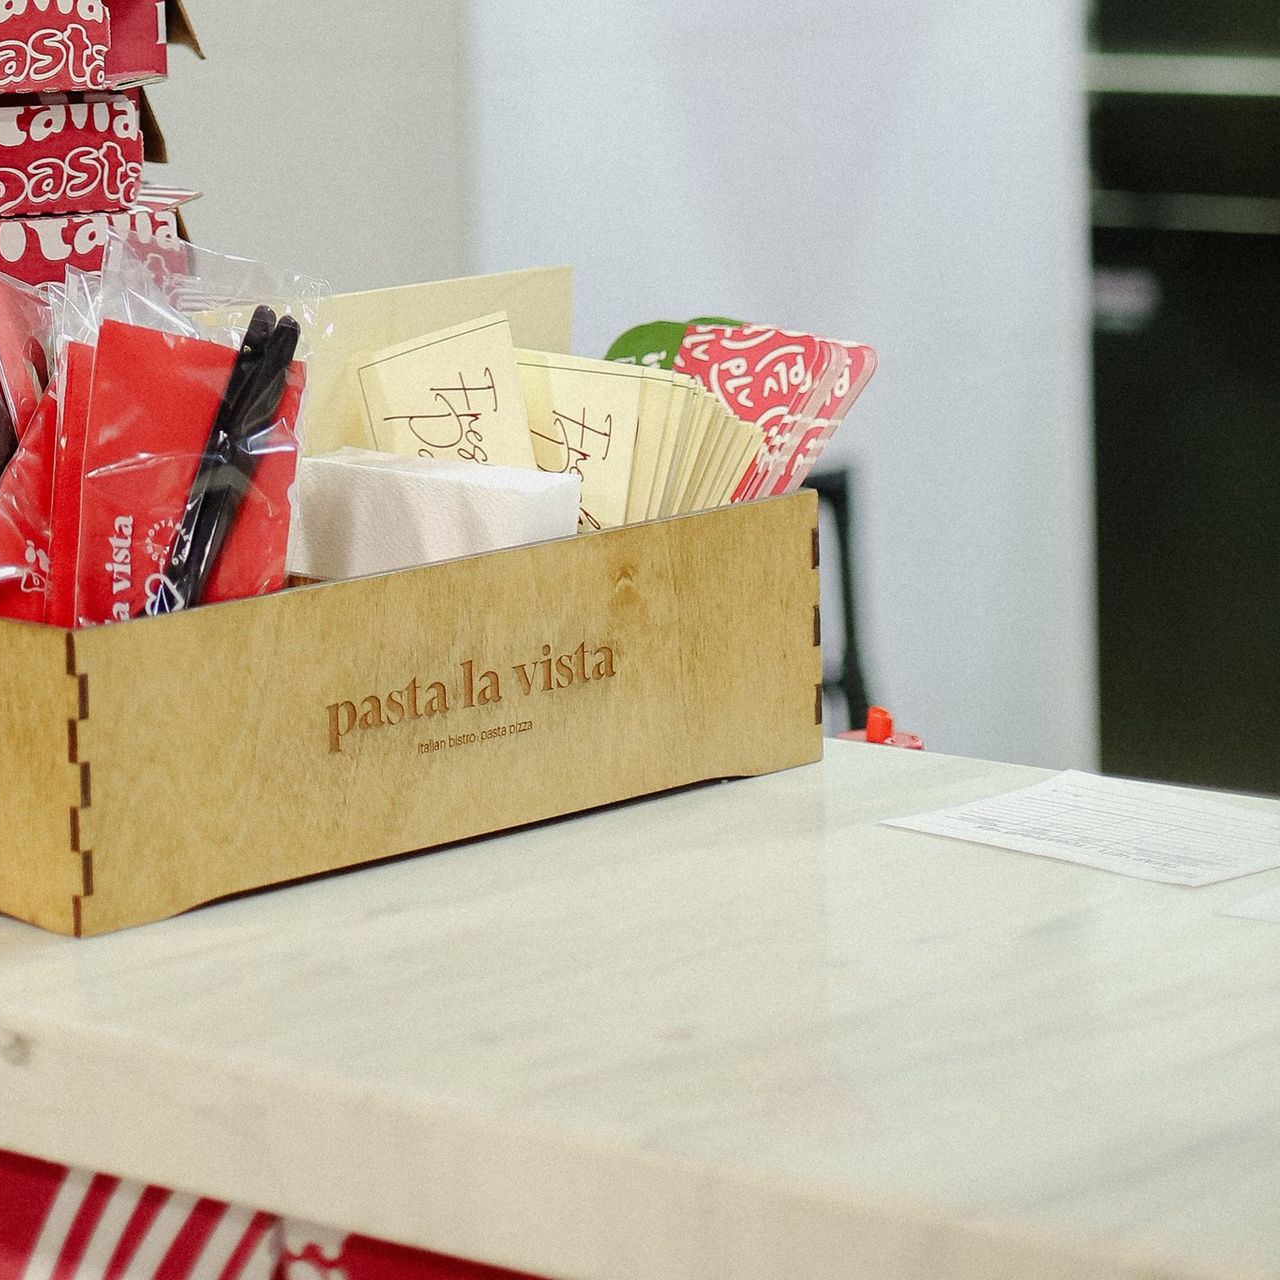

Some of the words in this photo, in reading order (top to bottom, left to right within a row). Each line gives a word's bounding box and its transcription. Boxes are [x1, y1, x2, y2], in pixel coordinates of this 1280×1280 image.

[105, 514, 134, 595] vista
[325, 675, 450, 754] pasta
[459, 659, 503, 709] la
[511, 640, 617, 696] vista
[448, 731, 476, 748] bistro
[480, 725, 507, 741] pasta
[509, 718, 534, 734] pizza
